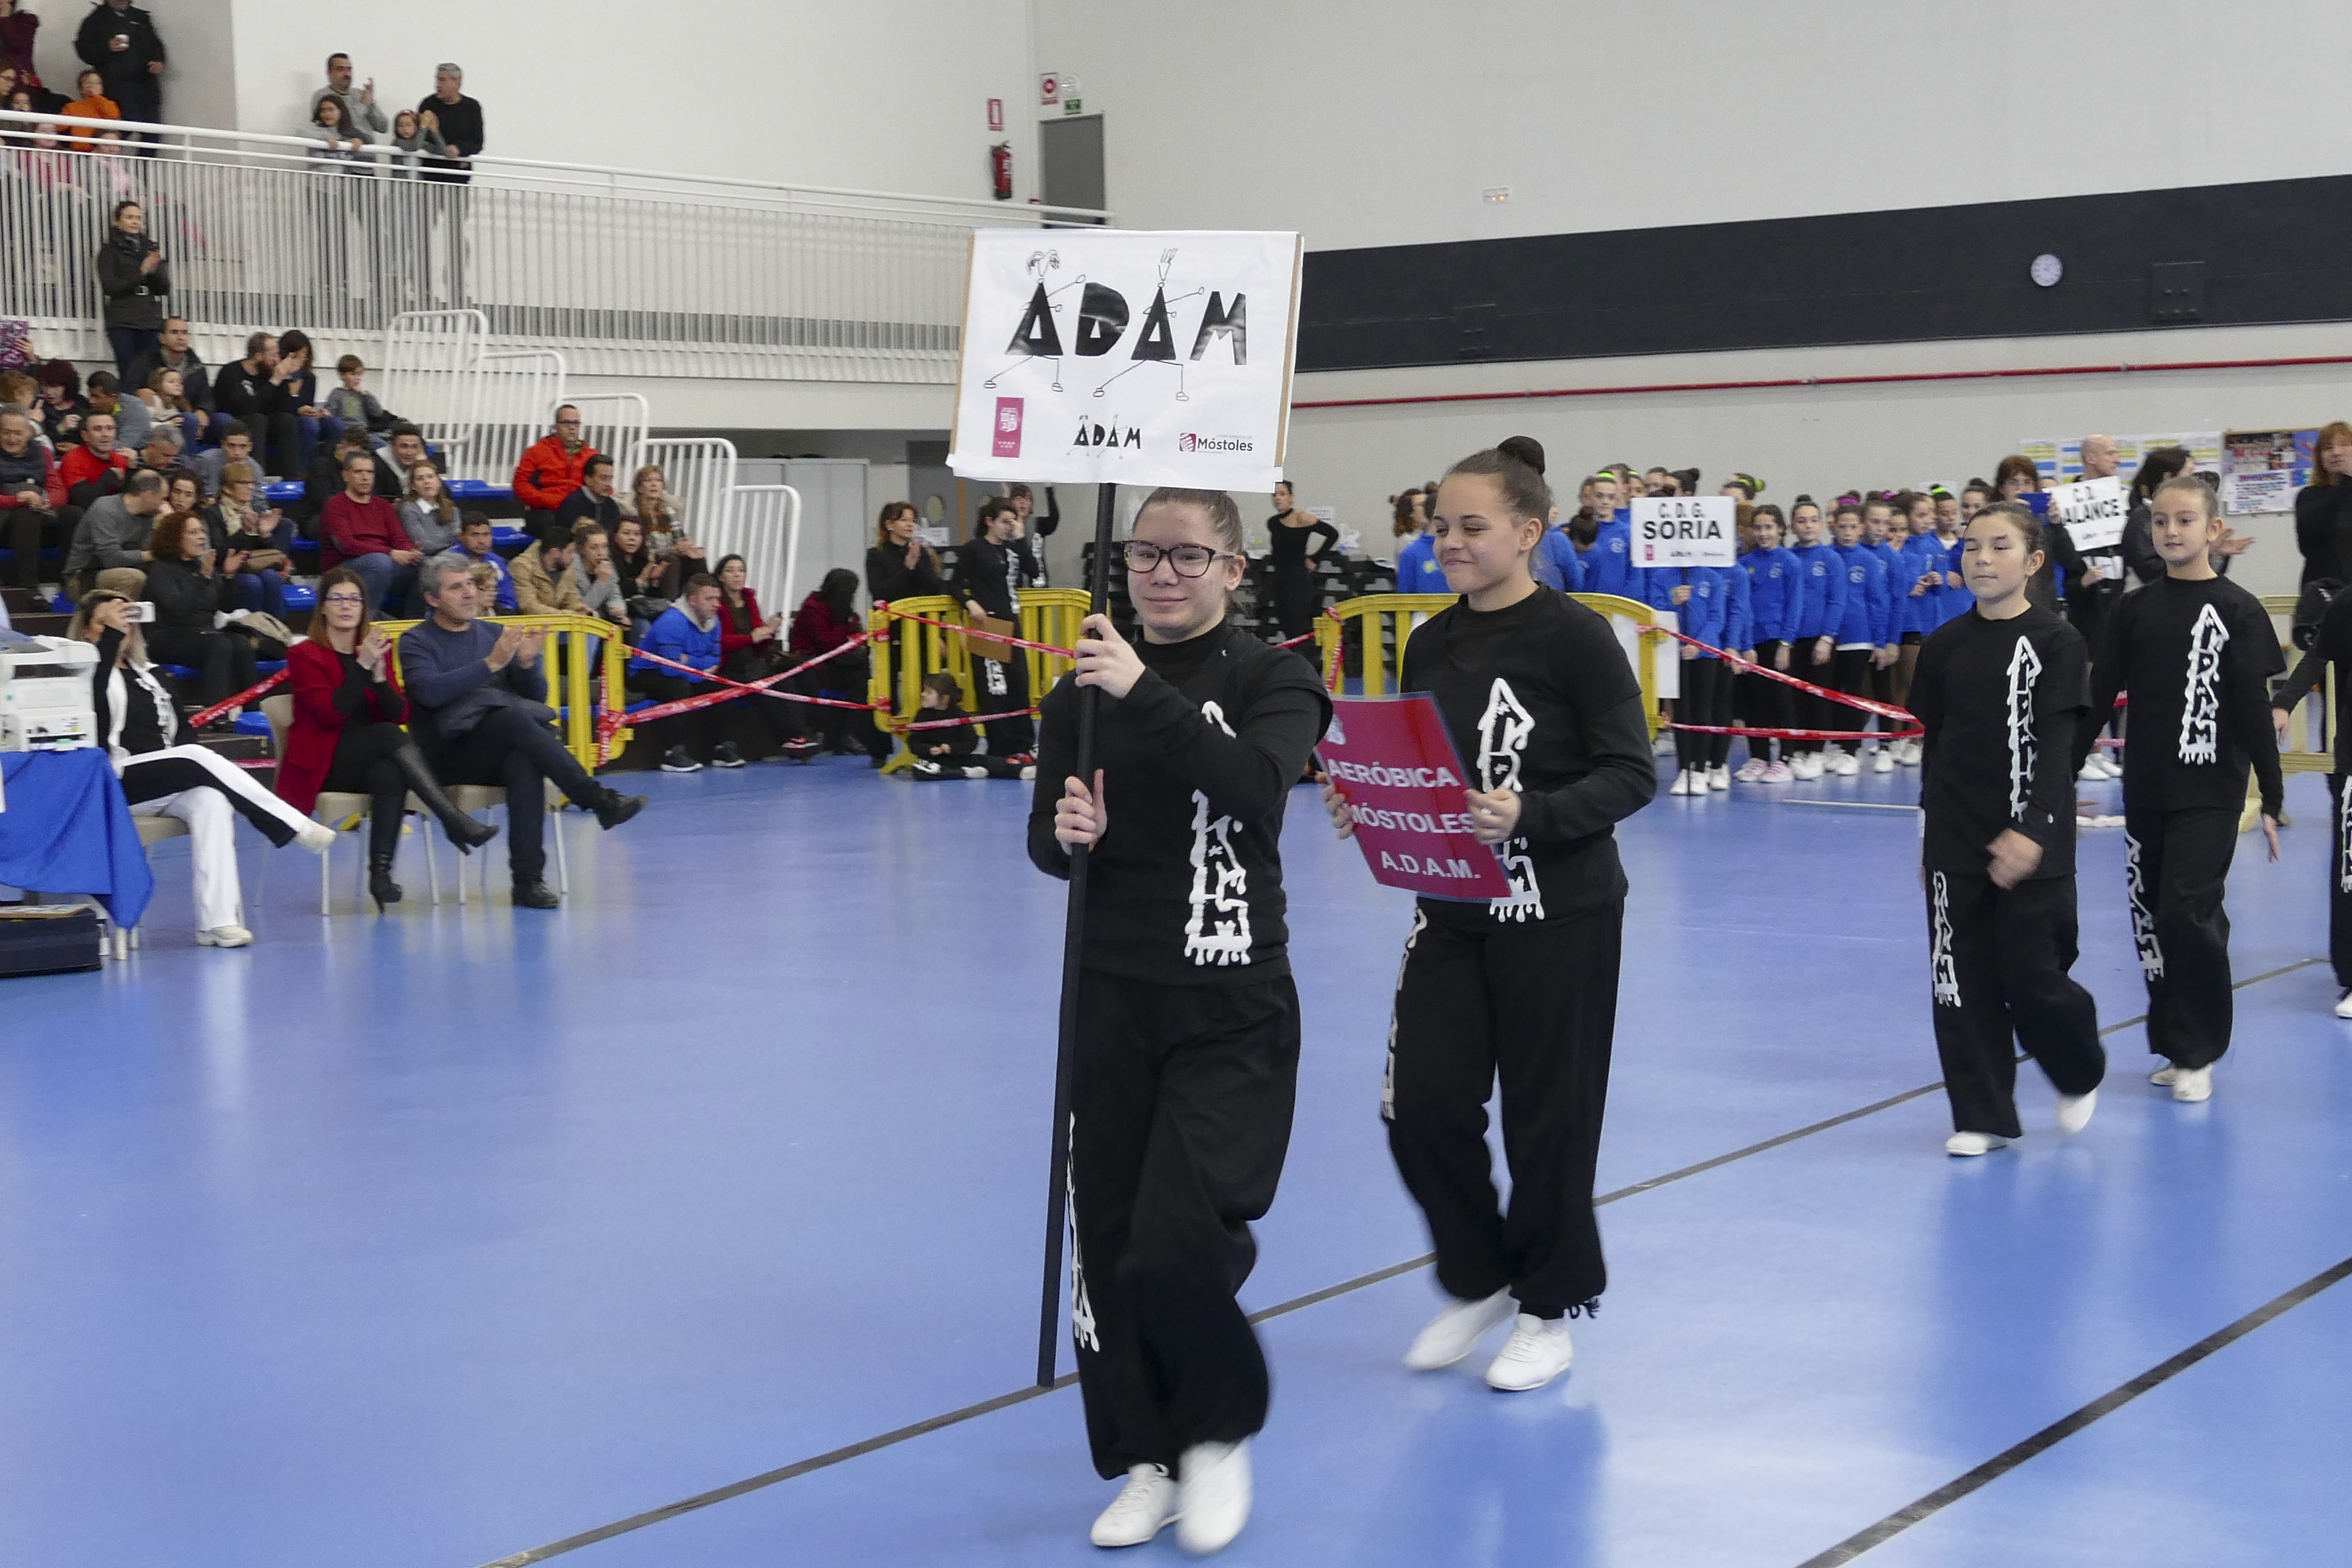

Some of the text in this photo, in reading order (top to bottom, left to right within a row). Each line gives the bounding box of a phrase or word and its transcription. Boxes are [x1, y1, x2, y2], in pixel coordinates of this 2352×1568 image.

[1005, 280, 1247, 366] ADAM
[1073, 423, 1141, 449] ADAM
[1197, 438, 1253, 451] Móstoles
[1643, 520, 1722, 540] SORIA
[1327, 758, 1461, 787] AERÓBICA
[1381, 851, 1481, 879] A.D.A.M.
